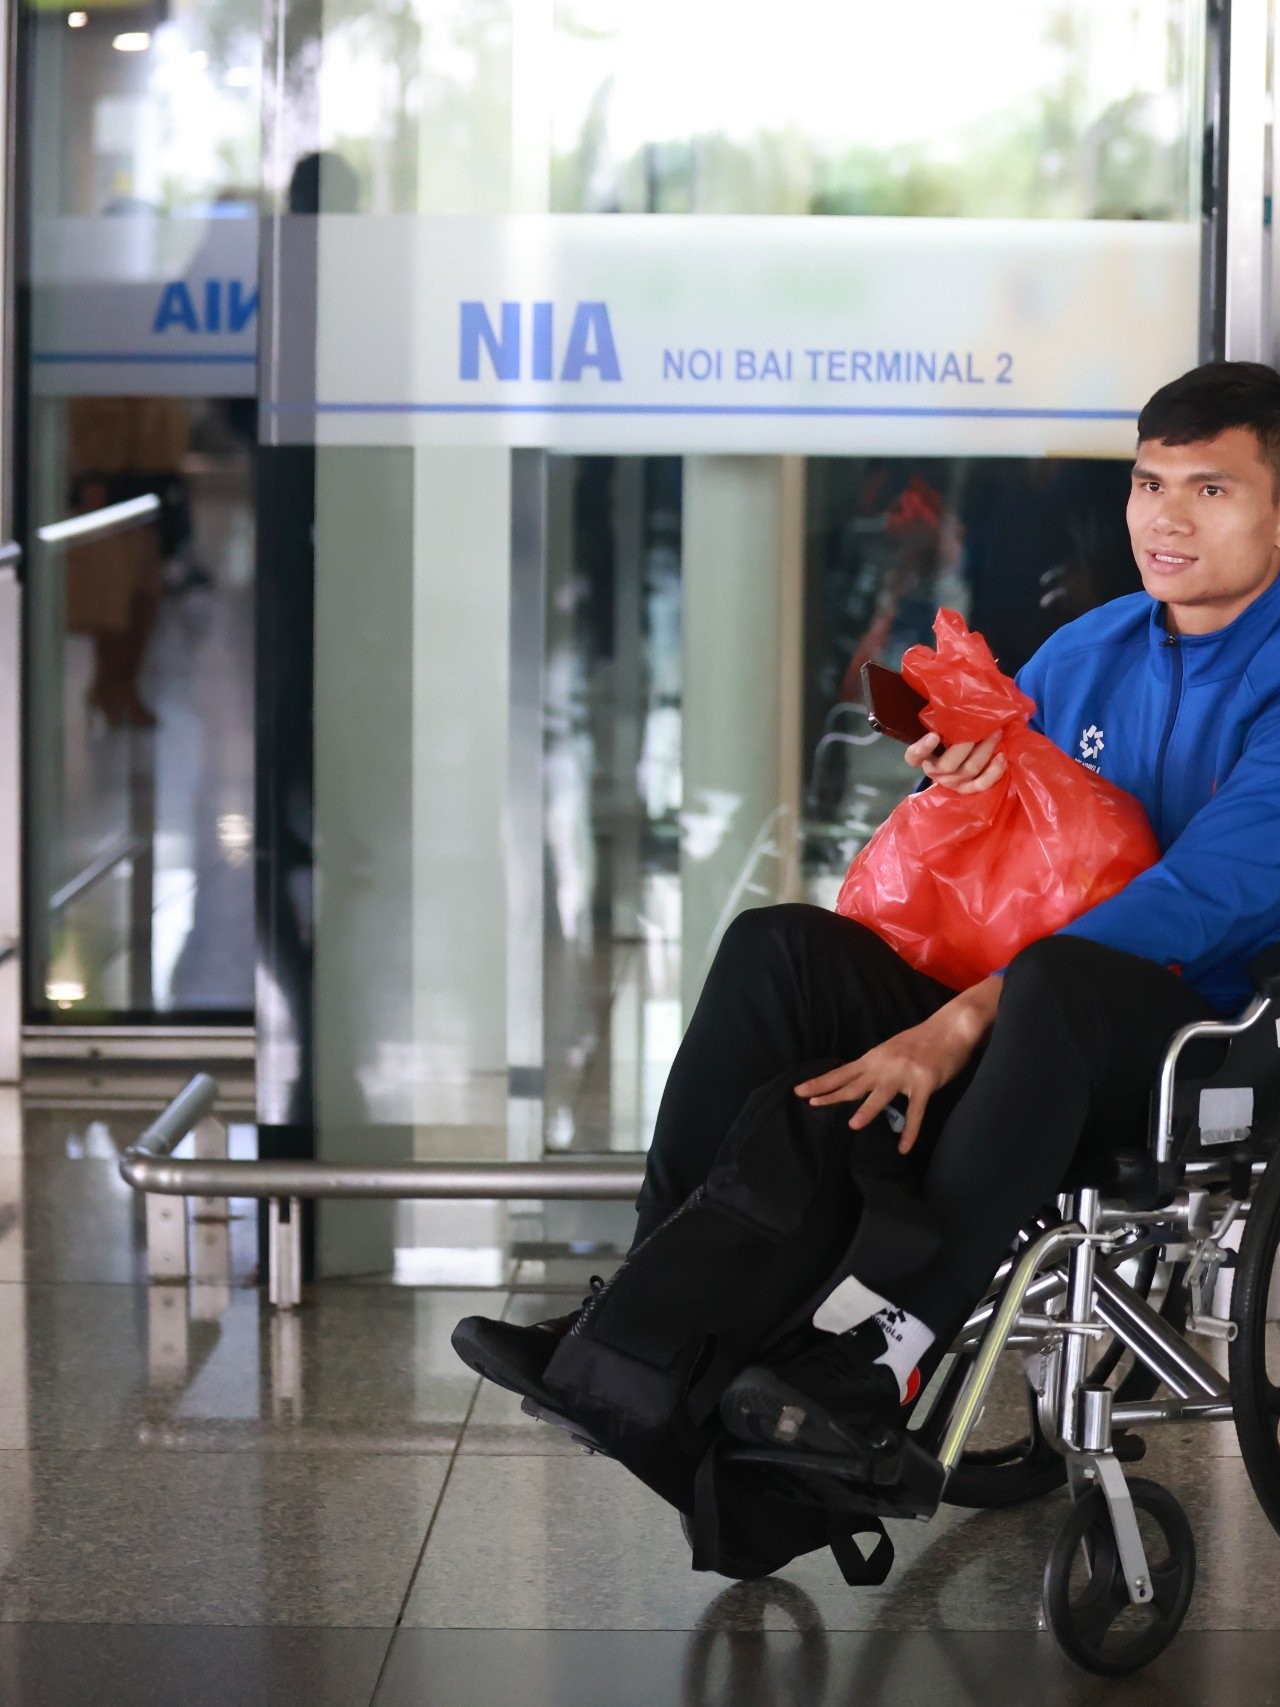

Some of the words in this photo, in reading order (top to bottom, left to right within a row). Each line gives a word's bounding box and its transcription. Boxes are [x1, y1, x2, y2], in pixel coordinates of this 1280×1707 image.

[459, 302, 622, 381] NIA
[663, 350, 721, 380] NOI
[736, 350, 793, 381] BAI
[806, 351, 985, 383] TERMINAL
[995, 353, 1013, 384] 2
